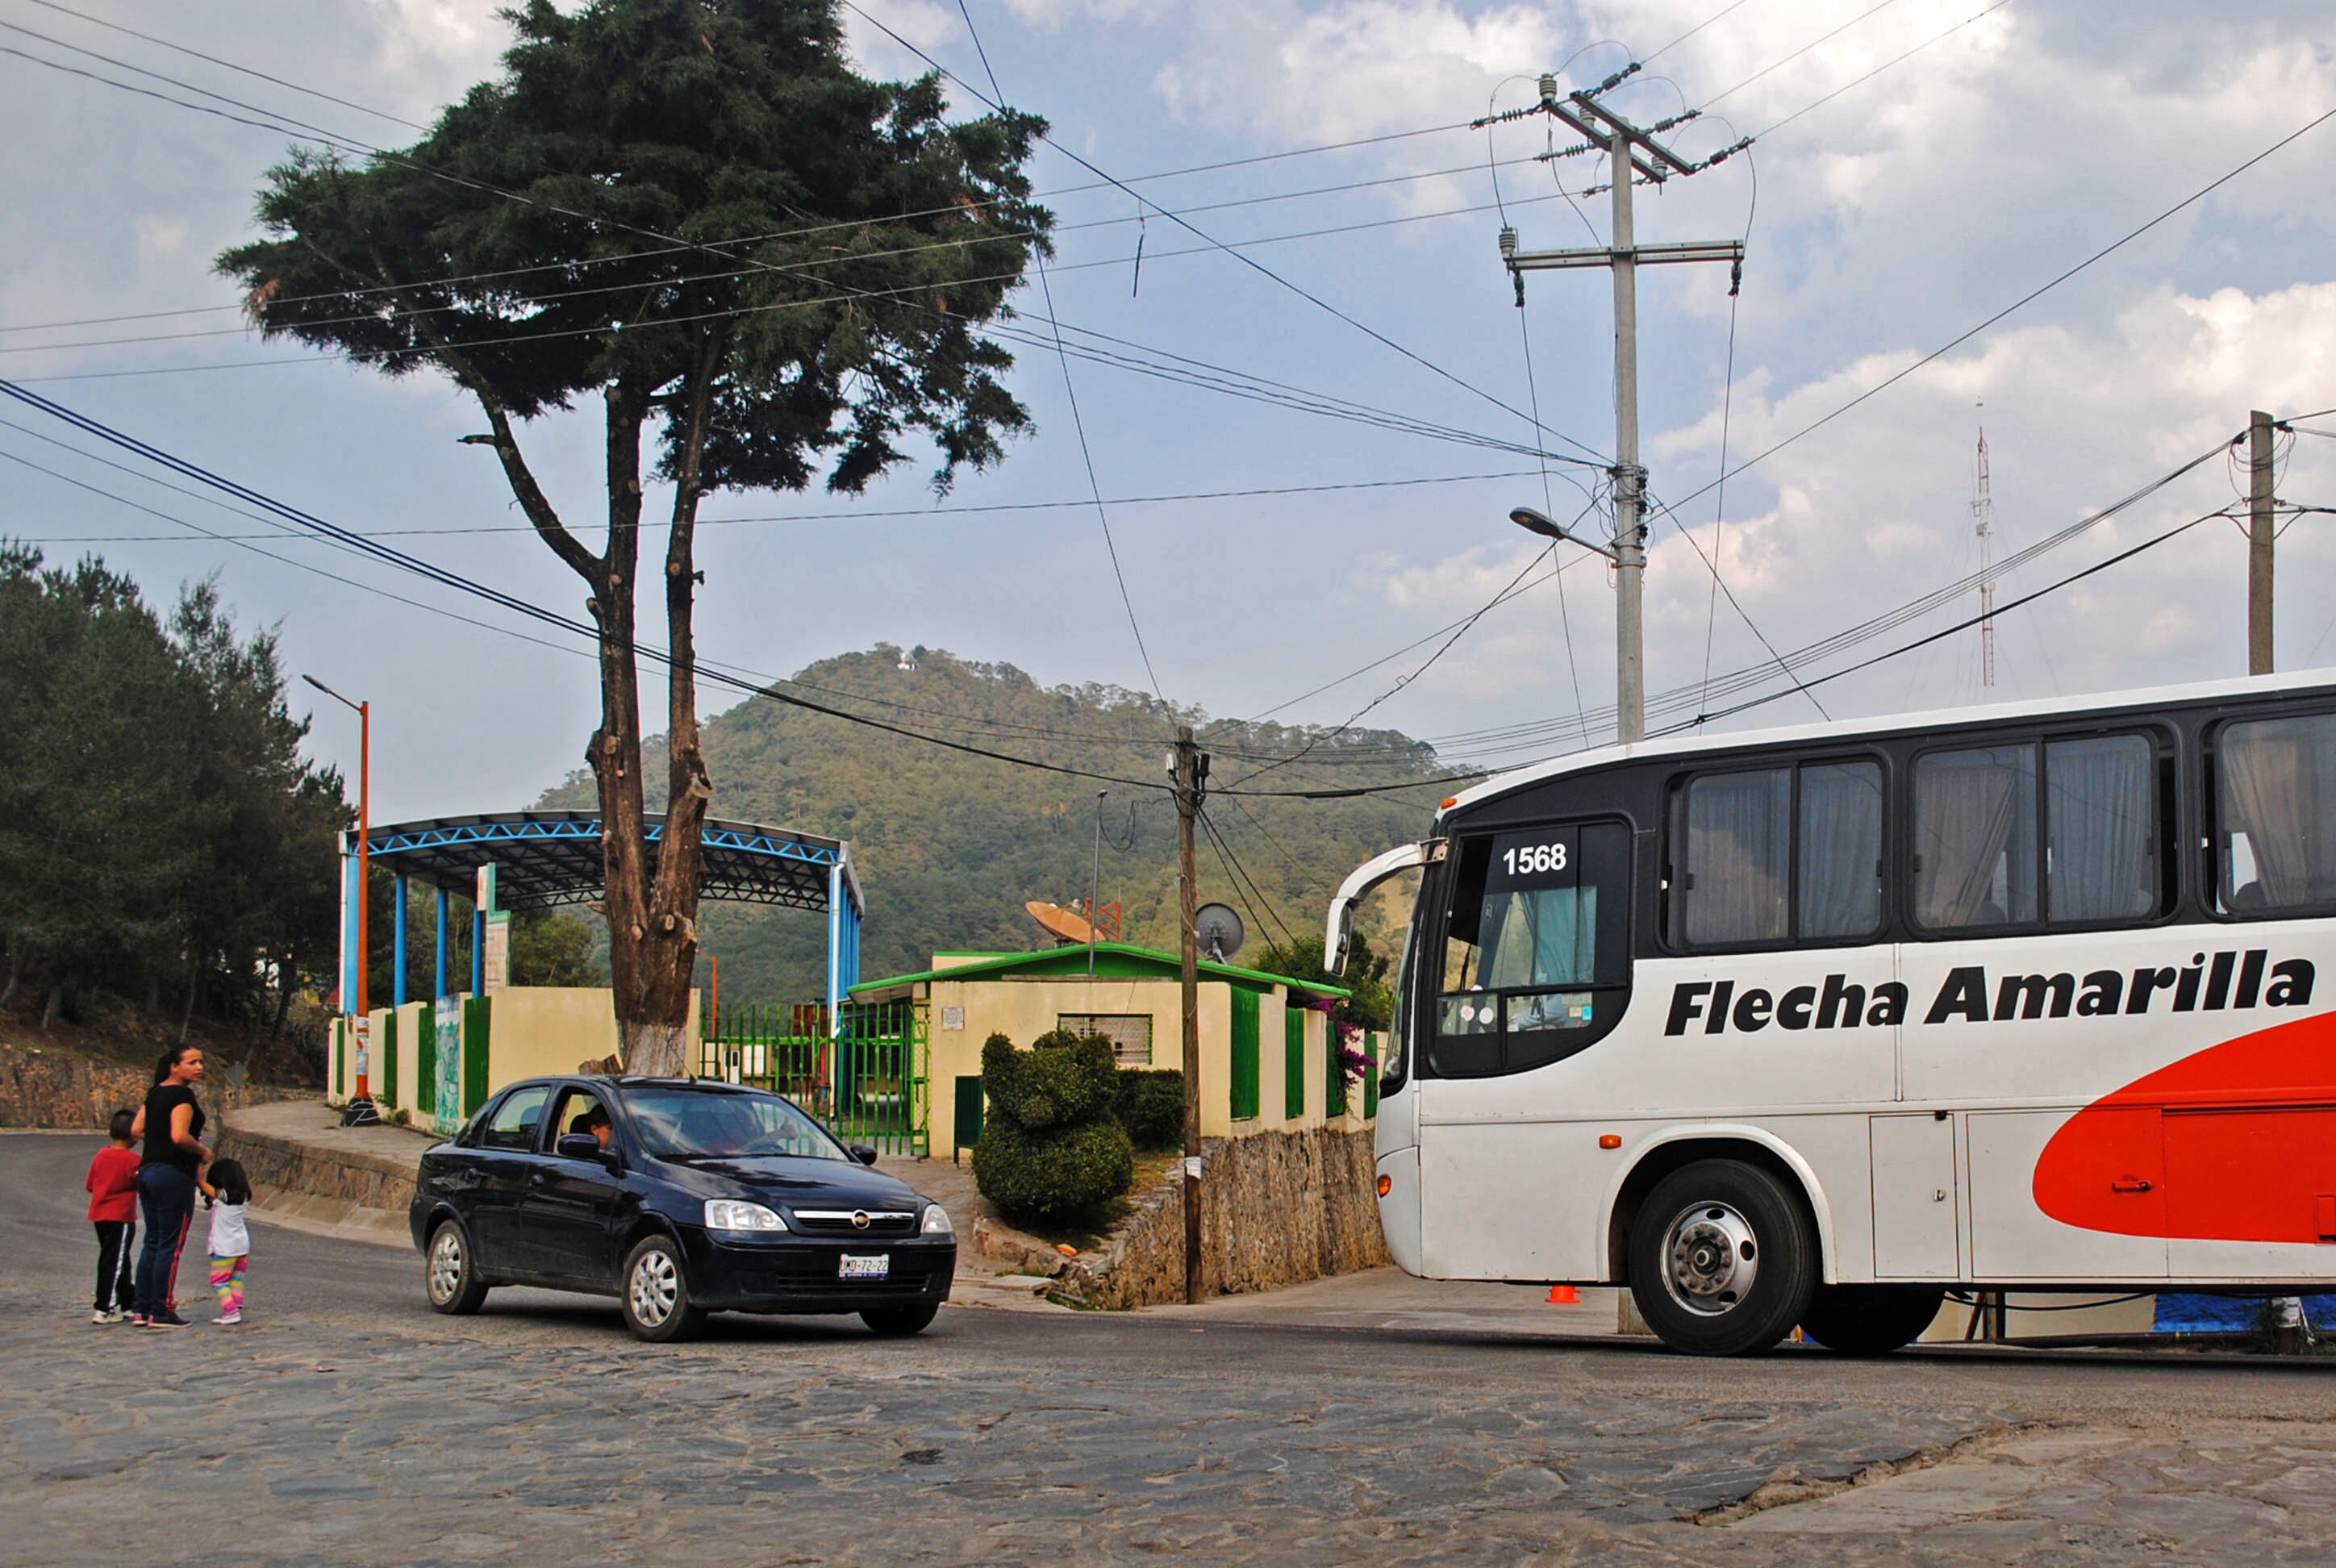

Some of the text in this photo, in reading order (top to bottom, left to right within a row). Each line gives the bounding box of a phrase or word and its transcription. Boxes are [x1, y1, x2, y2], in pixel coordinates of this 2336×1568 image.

[1504, 843, 1566, 875] 1568
[1664, 949, 2316, 1036] Flecha Amarilla
